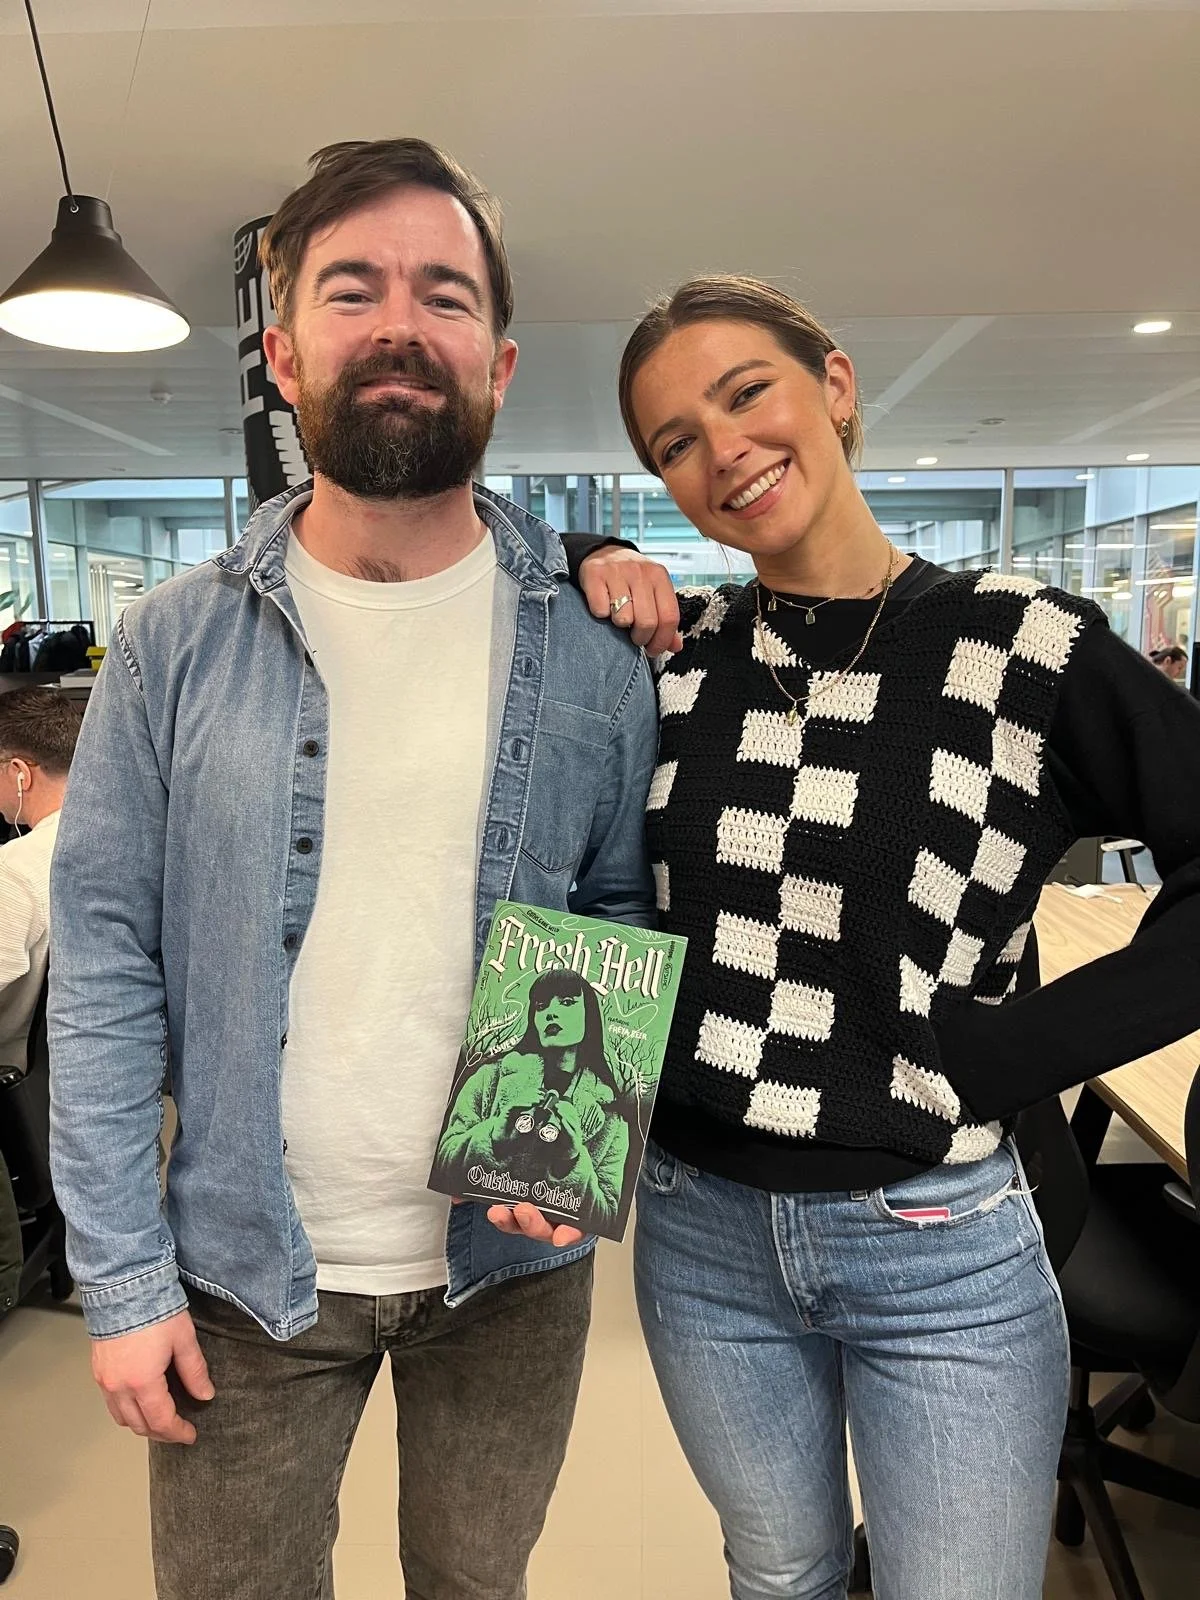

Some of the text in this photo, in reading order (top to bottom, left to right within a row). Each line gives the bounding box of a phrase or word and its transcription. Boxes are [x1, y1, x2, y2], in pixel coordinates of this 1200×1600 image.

[488, 913, 666, 1001] Fresh Hell
[467, 1164, 582, 1212] Outsiders Outside
